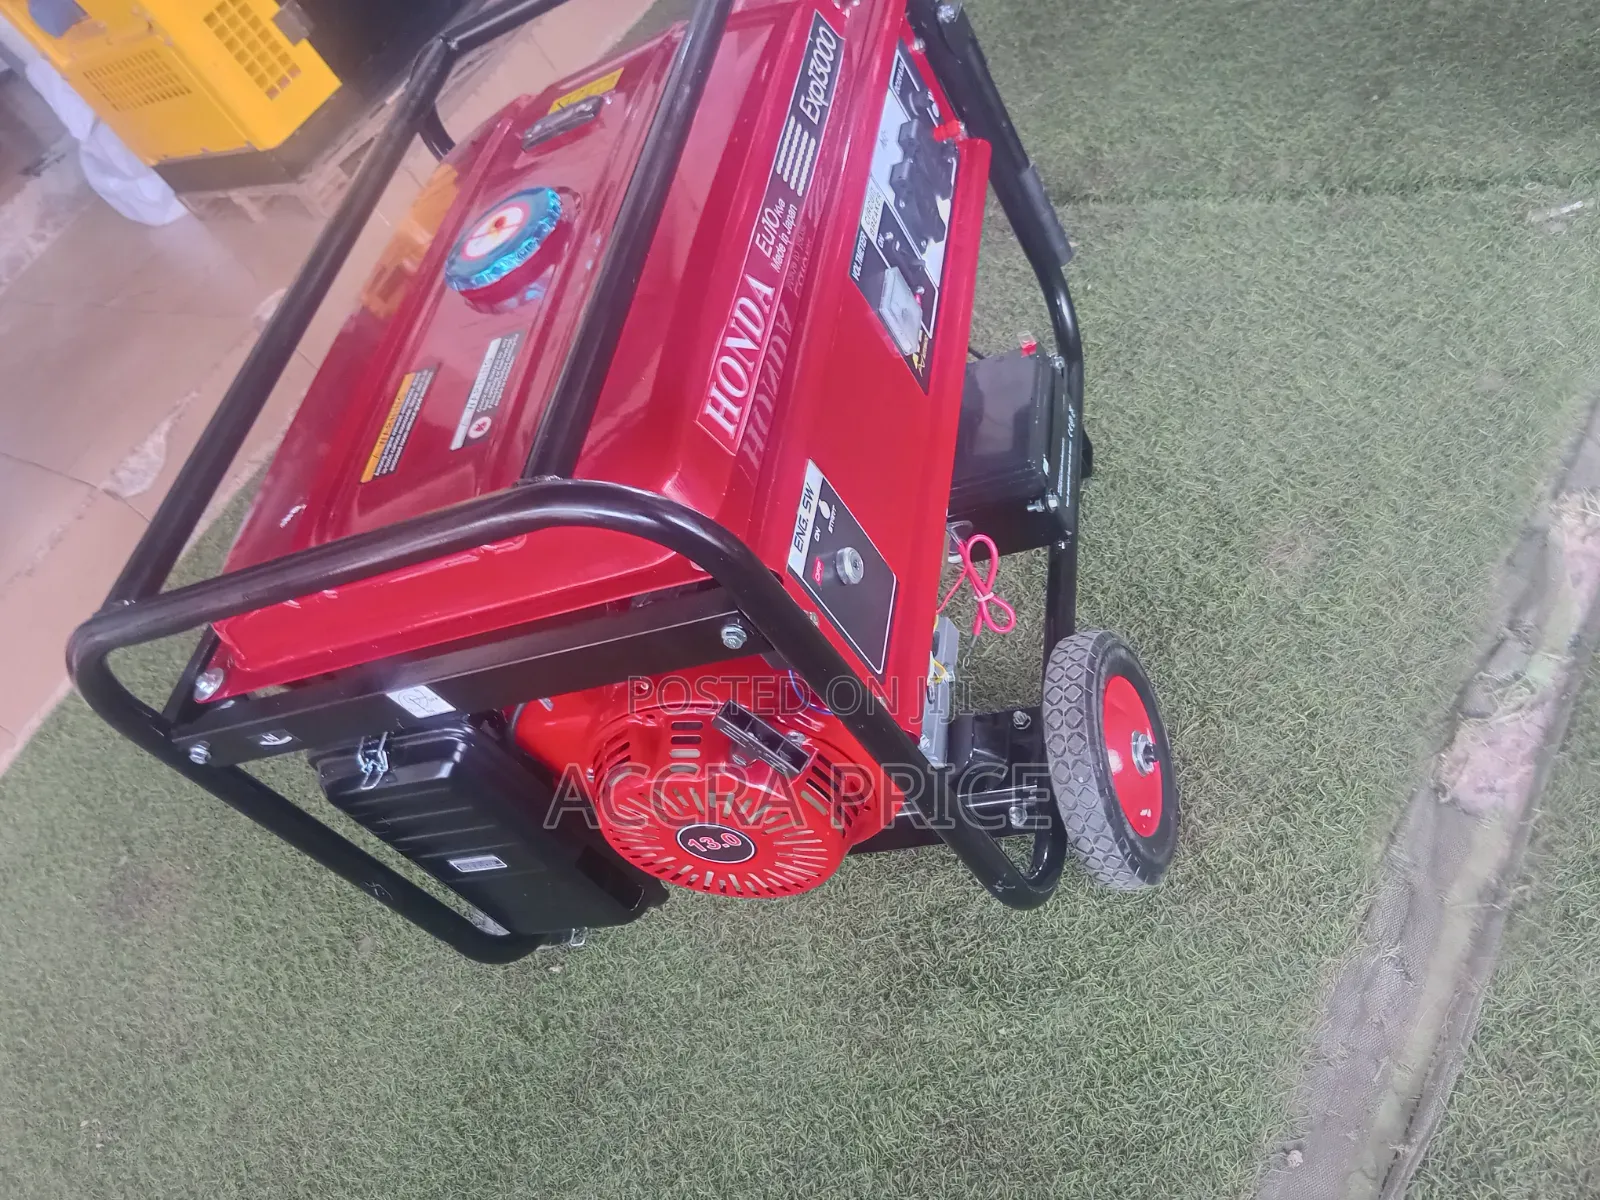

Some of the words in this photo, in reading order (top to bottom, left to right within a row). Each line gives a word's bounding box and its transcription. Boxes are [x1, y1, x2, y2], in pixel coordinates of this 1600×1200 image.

[799, 26, 837, 125] Exp13000
[771, 242, 786, 274] Made
[782, 204, 798, 235] Japan
[851, 230, 868, 282] VOLTMETER
[703, 272, 776, 441] HONDA
[793, 514, 809, 553] ENG.
[803, 482, 815, 514] SW
[814, 526, 822, 542] ON
[687, 833, 742, 852] 13.0
